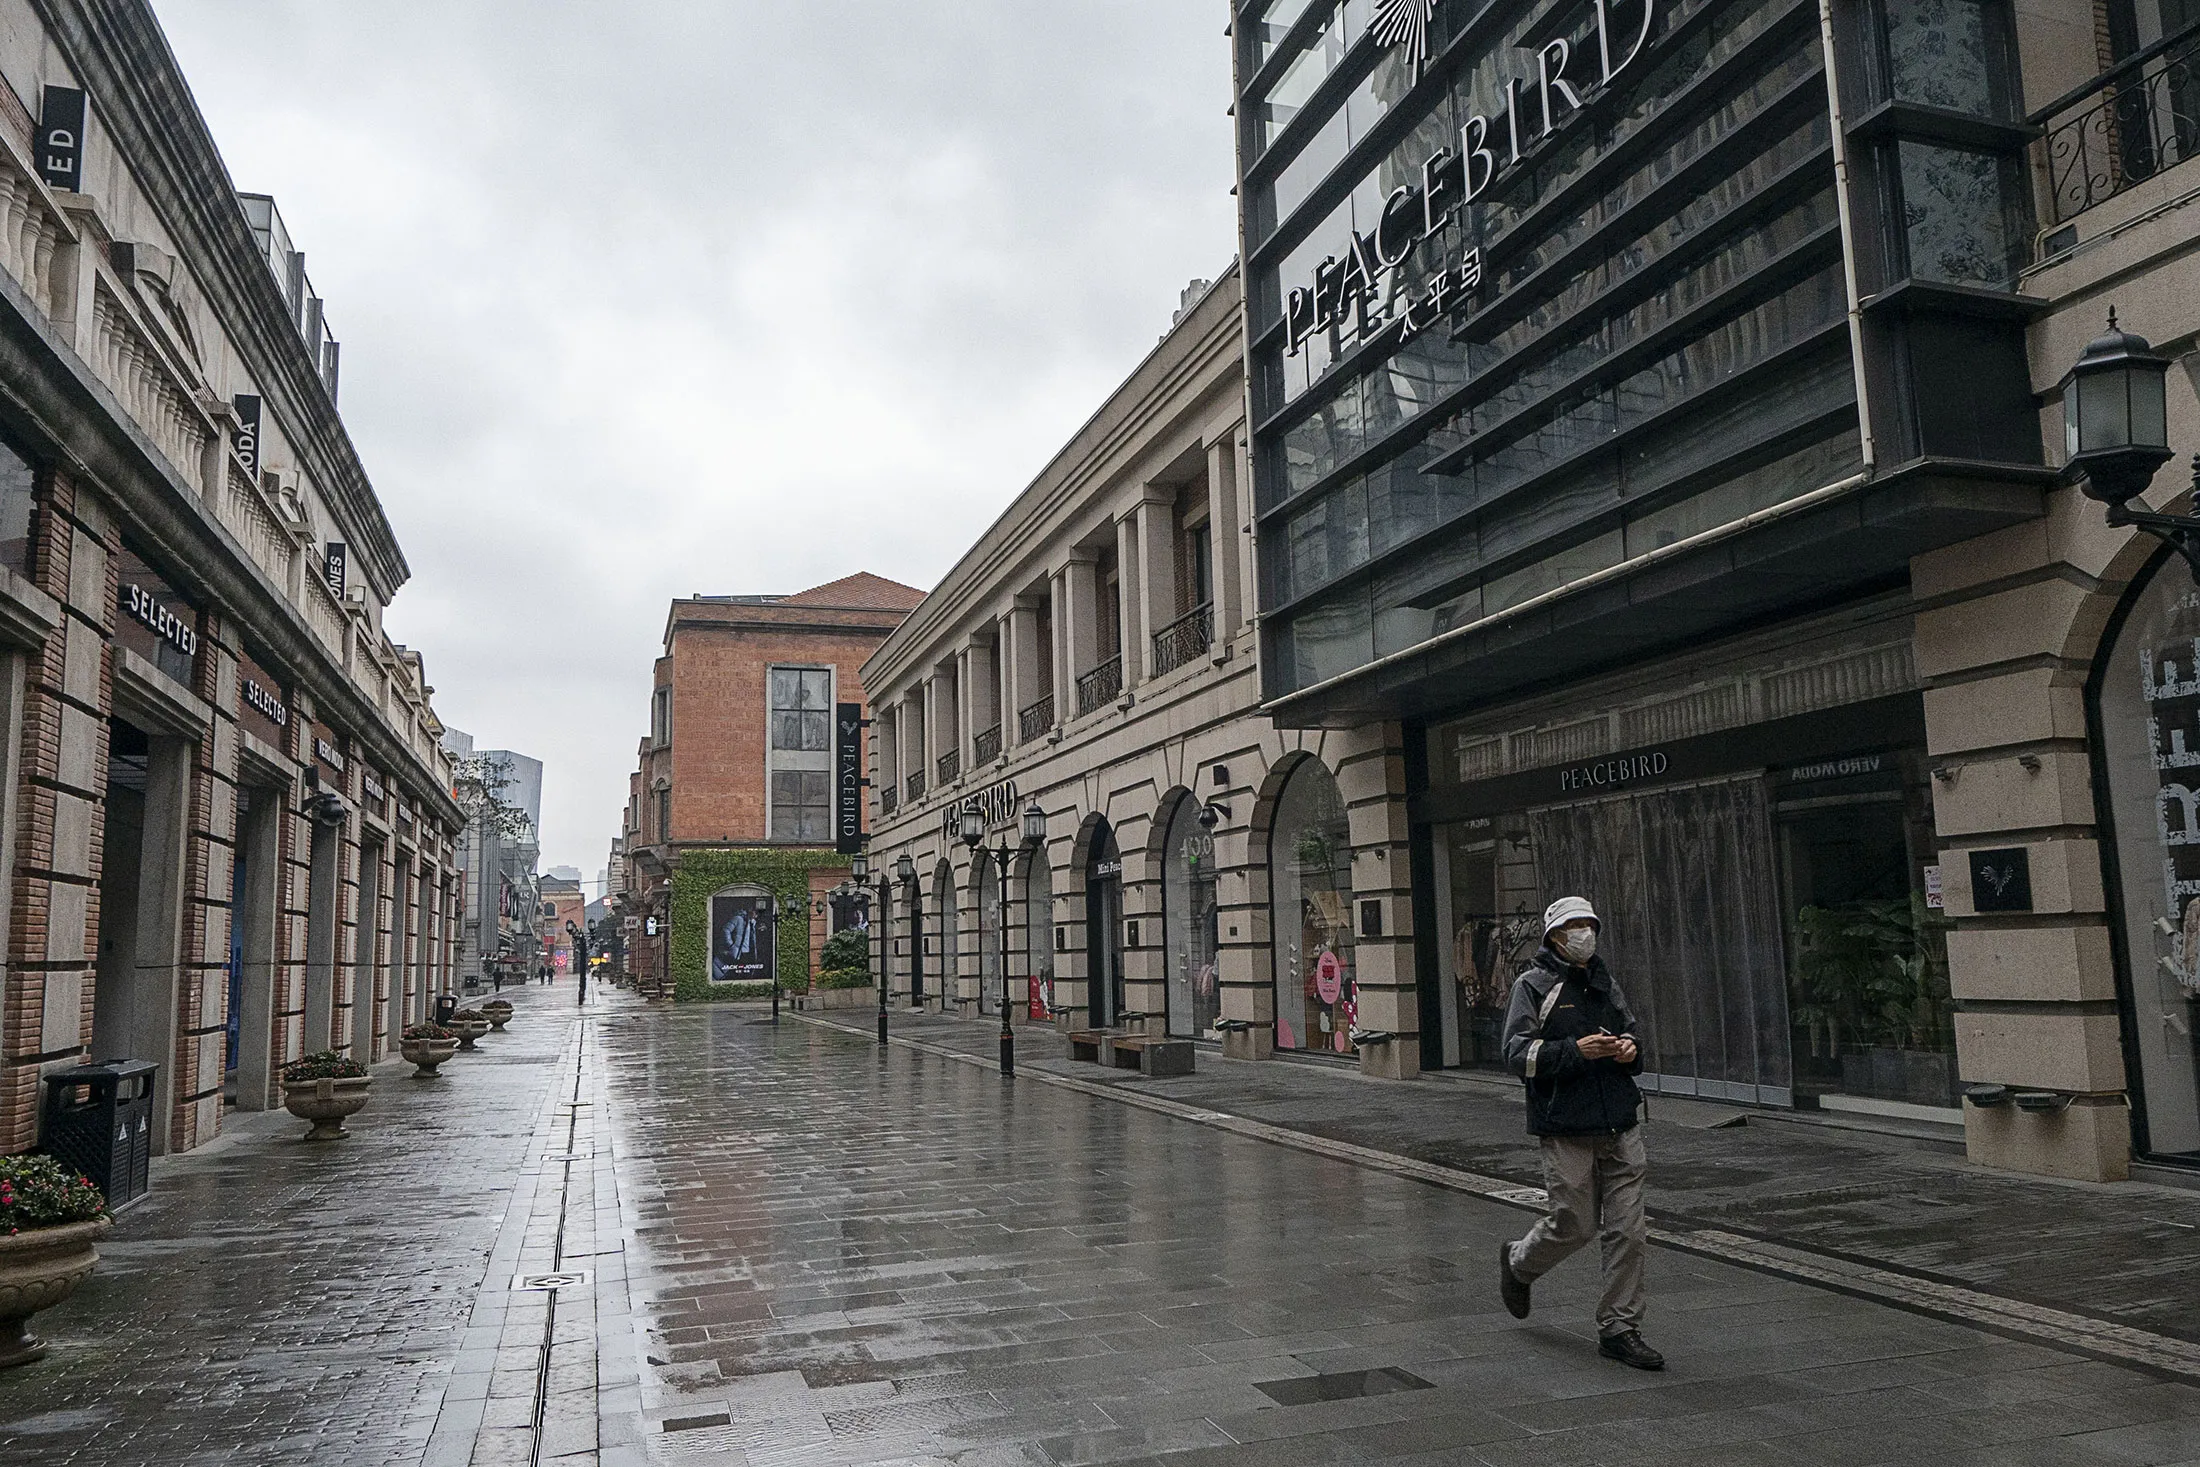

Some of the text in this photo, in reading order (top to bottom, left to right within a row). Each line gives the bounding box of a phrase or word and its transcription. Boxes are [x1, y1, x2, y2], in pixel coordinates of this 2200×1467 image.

[1284, 0, 1655, 356] PEACEBIRD
[1399, 246, 1481, 343] 太平鸟
[131, 583, 196, 656] SELECTED
[248, 679, 287, 726] SELECTED
[843, 744, 856, 836] PEACEBIRD
[1561, 752, 1668, 791] PEACEBIRD
